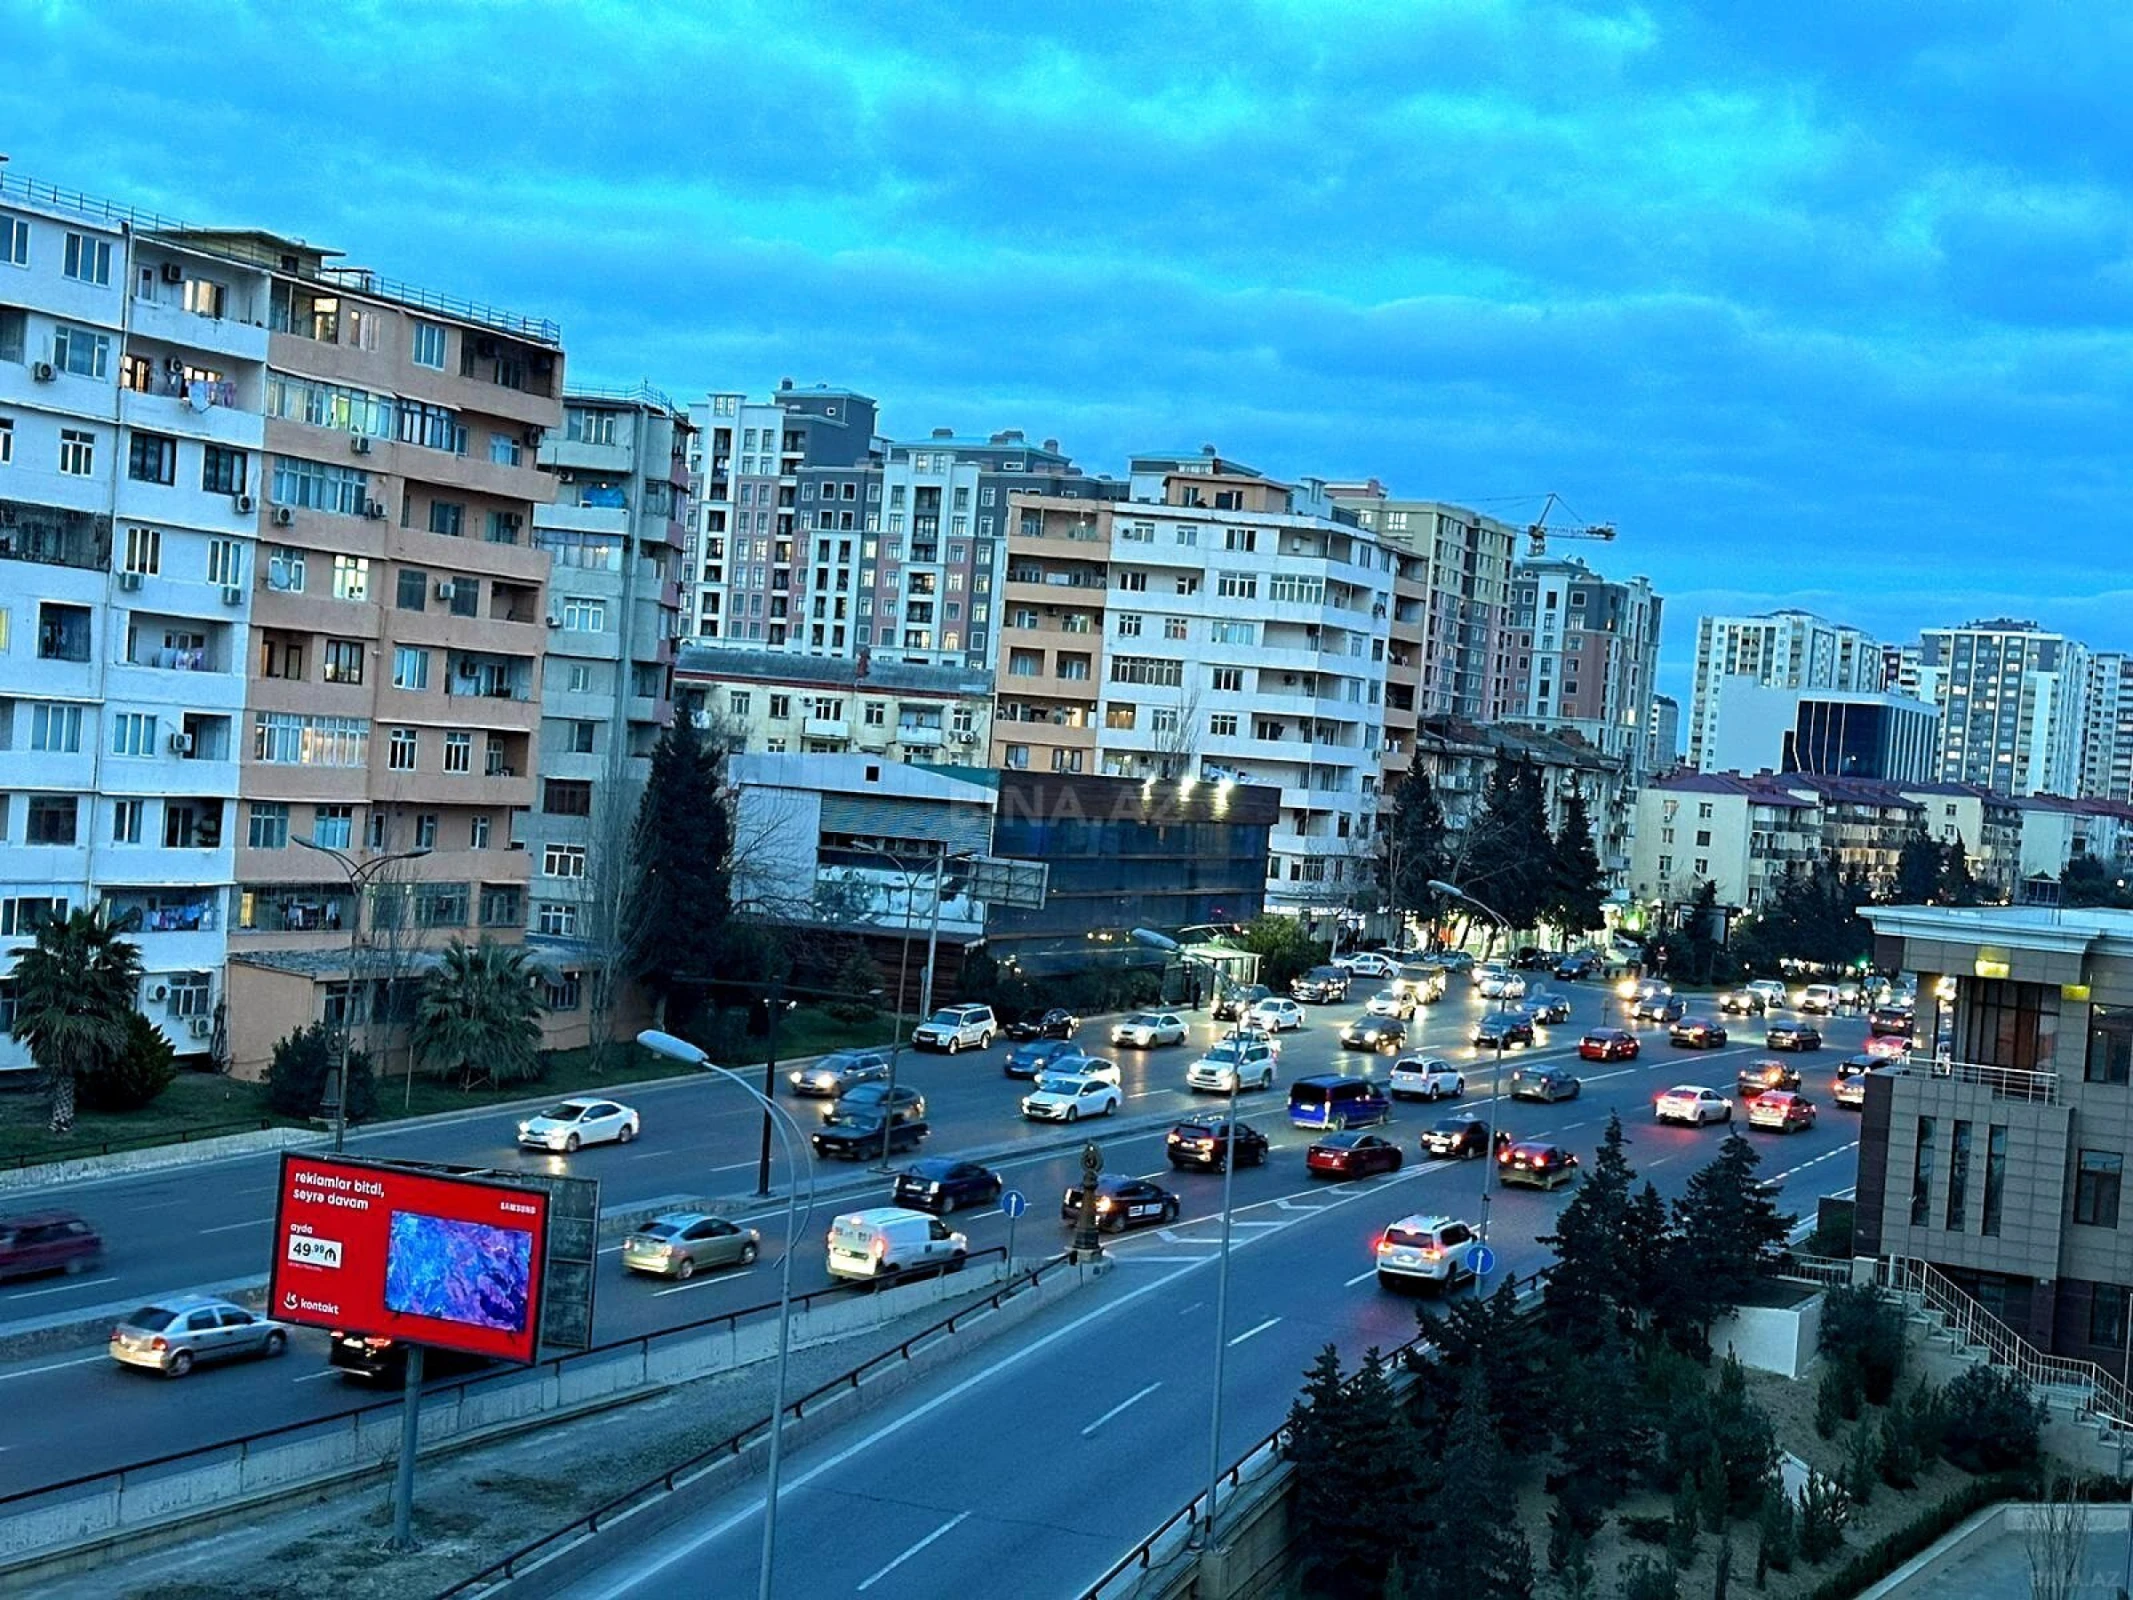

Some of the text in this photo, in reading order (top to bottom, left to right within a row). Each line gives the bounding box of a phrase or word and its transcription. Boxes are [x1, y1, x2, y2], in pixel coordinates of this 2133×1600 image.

[295, 1172, 352, 1191] reklamlar
[327, 1192, 369, 1211] davam
[290, 1223, 313, 1235] ayda
[300, 1298, 339, 1316] kontakt
